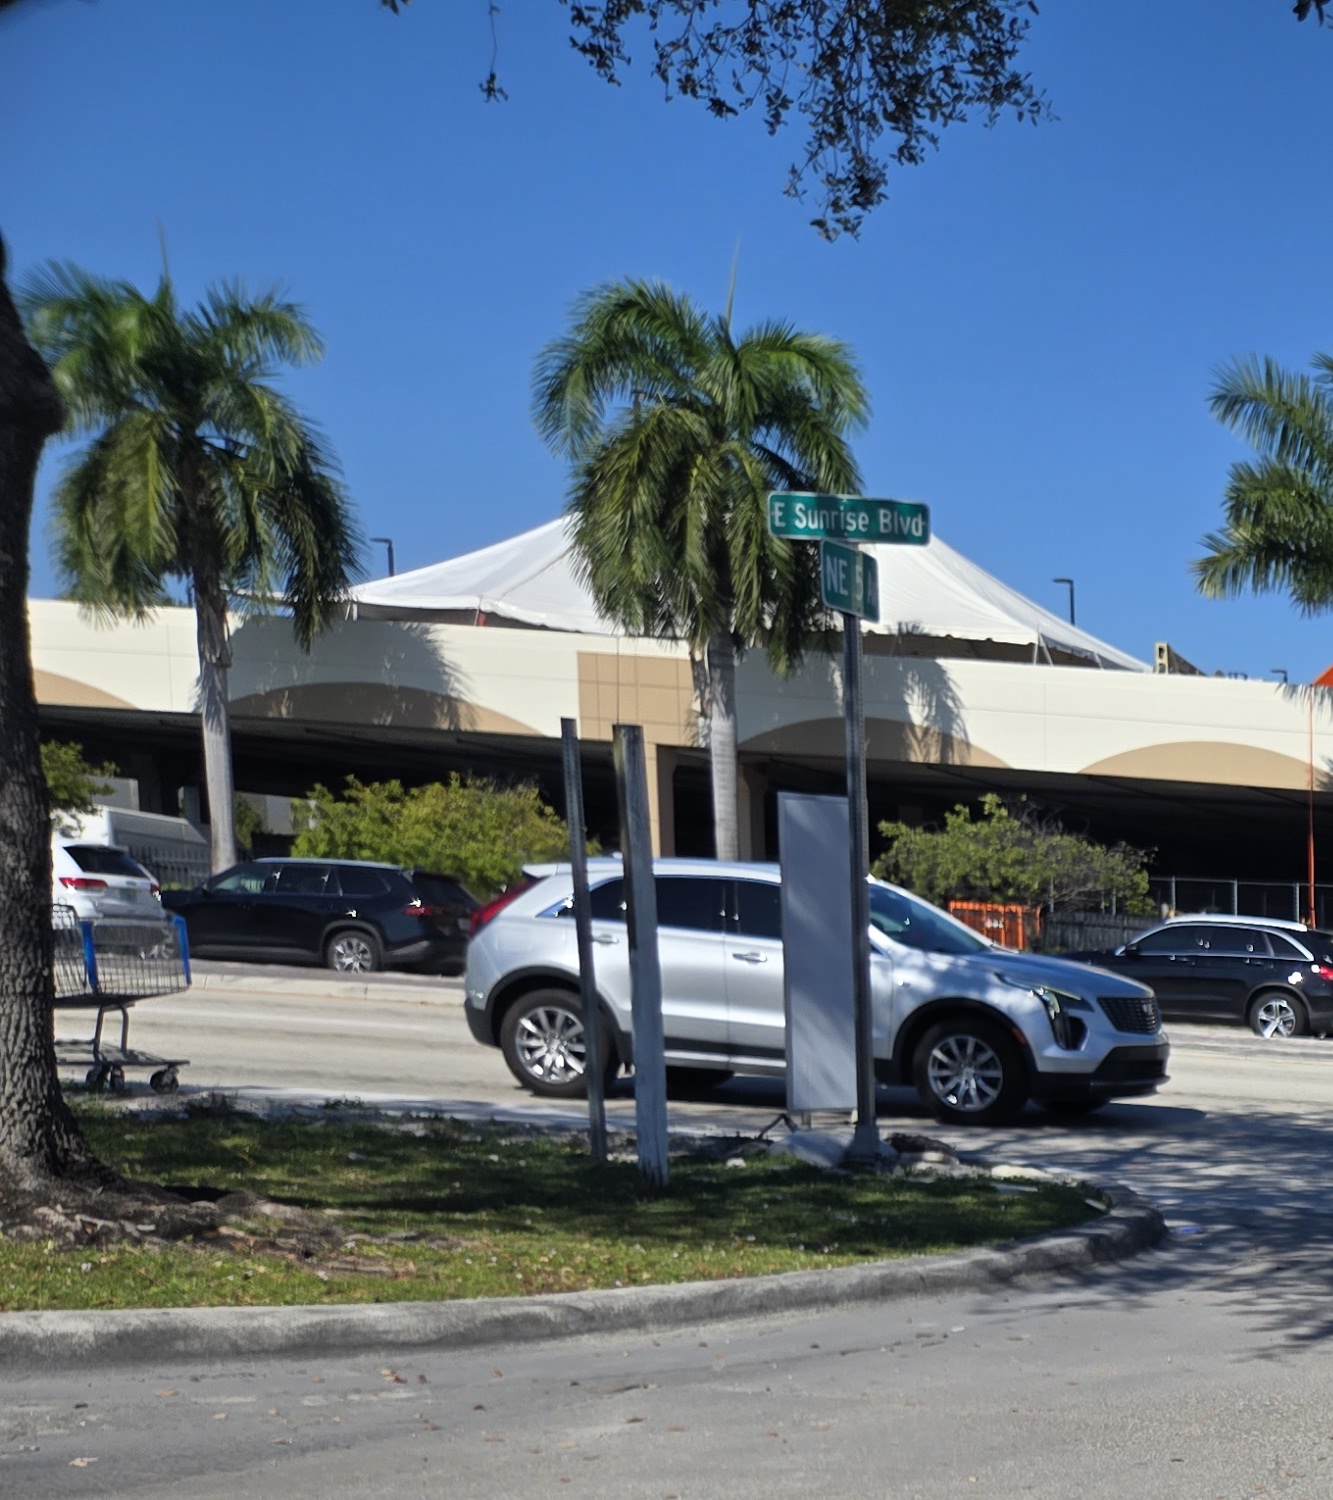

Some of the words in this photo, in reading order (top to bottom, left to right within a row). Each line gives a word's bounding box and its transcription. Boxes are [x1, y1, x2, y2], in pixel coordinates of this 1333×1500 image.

[774, 502, 787, 528] E
[794, 503, 869, 533] Sunrise
[879, 508, 924, 537] Blvd
[825, 555, 849, 596] NE
